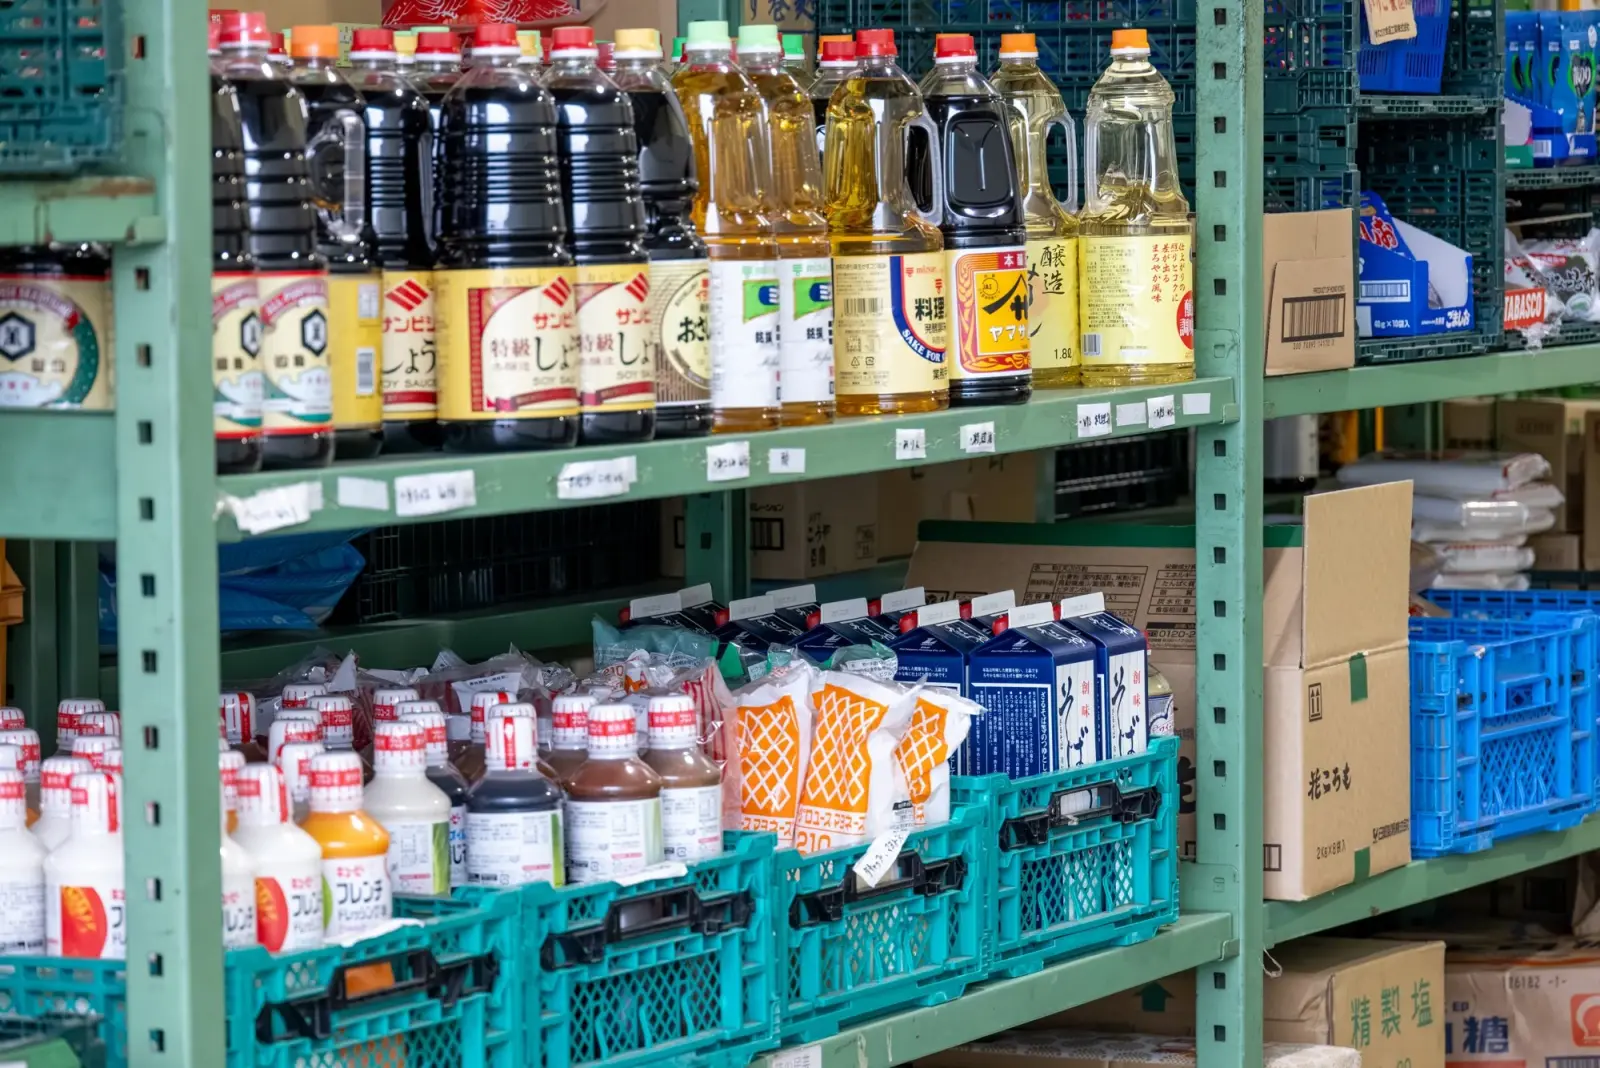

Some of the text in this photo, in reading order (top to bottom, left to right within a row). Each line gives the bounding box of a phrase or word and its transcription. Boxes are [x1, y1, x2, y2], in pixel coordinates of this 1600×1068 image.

[1504, 292, 1543, 321] TABASCO
[902, 329, 941, 362] SAKE FOR
[1308, 761, 1351, 801] 花ころも
[797, 830, 832, 853] 210
[336, 879, 383, 905] フレンチ
[1351, 977, 1434, 1050] 精製塩
